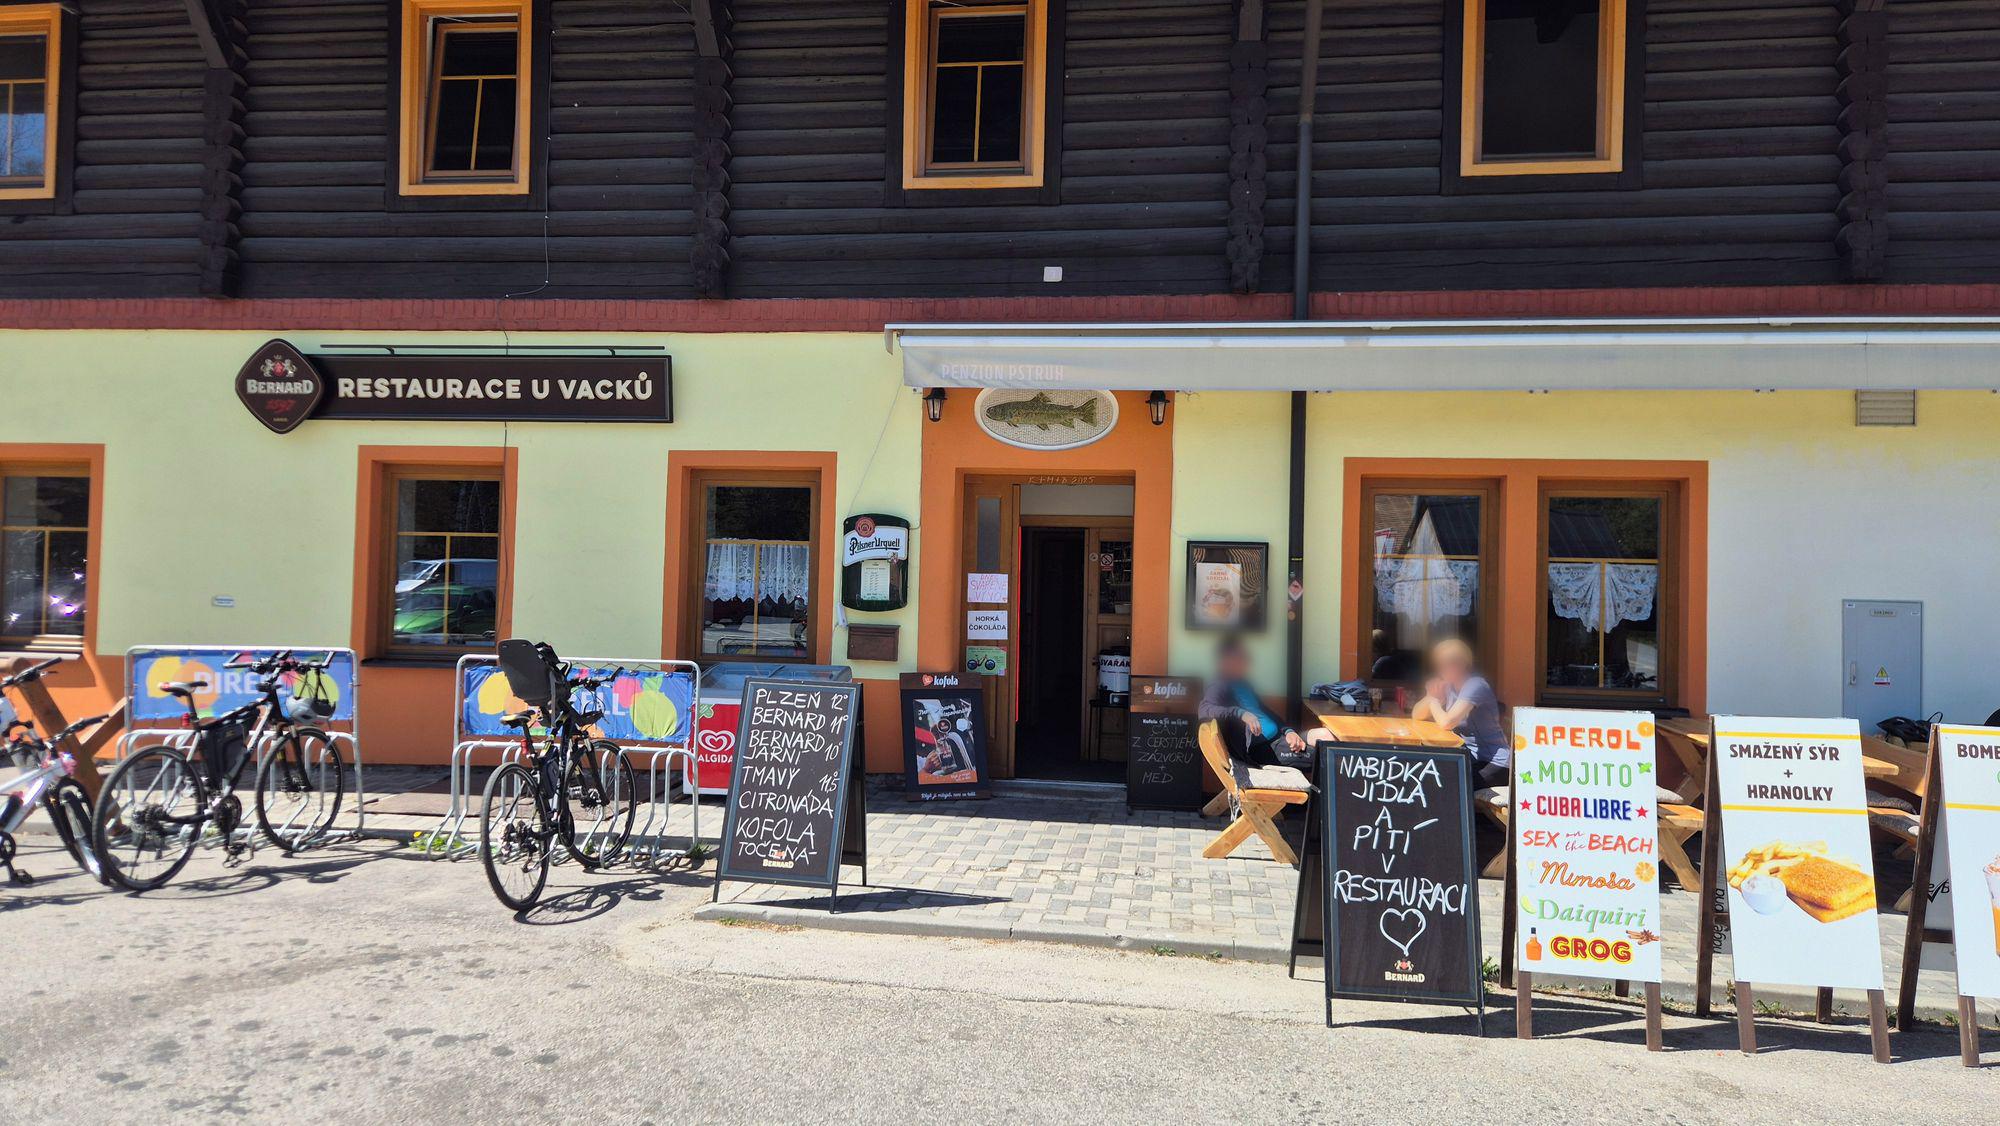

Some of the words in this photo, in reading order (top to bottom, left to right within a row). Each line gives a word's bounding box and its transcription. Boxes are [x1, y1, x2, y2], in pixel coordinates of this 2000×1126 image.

[941, 363, 1004, 381] PENZION
[1009, 364, 1064, 381] PSTRUH
[246, 379, 314, 395] BERNARD
[338, 377, 522, 400] RESTAURACE
[532, 379, 550, 400] U
[558, 371, 653, 401] VACKŮ
[849, 537, 875, 556] Pilsner
[875, 537, 900, 551] Urquell
[968, 623, 1007, 631] ČOKOLÁDA
[933, 675, 959, 687] kofola
[1153, 682, 1187, 698] kofola
[756, 688, 821, 709] PLZEŇ
[752, 707, 826, 731] BERNARD
[749, 729, 826, 753] BERNARD
[1534, 725, 1641, 750] APEROL
[697, 754, 733, 763] ALGIDA
[1729, 741, 1803, 760] SMAŽENÝ
[1809, 743, 1840, 761] SÝR
[742, 766, 800, 789] TMAVÝ
[1142, 771, 1174, 784] MED
[1340, 755, 1443, 787] NABÍDKA
[1538, 759, 1633, 788] MOJITO
[738, 789, 834, 819] CITRONÁDA
[1352, 777, 1427, 808] JÍDLA
[1746, 784, 1834, 802] HRANOLKY
[1375, 805, 1393, 830] A
[735, 816, 816, 849] KOFOLA
[1523, 829, 1560, 848] SEX
[1587, 833, 1653, 855] BEACH
[762, 859, 795, 869] BERNARD
[1381, 852, 1395, 874] V
[1539, 860, 1636, 891] Mimosa
[1333, 869, 1468, 916] RESTAURACI
[1537, 899, 1647, 933] Daiquiri
[1550, 936, 1632, 964] GROG
[1384, 971, 1425, 983] BERNARD
